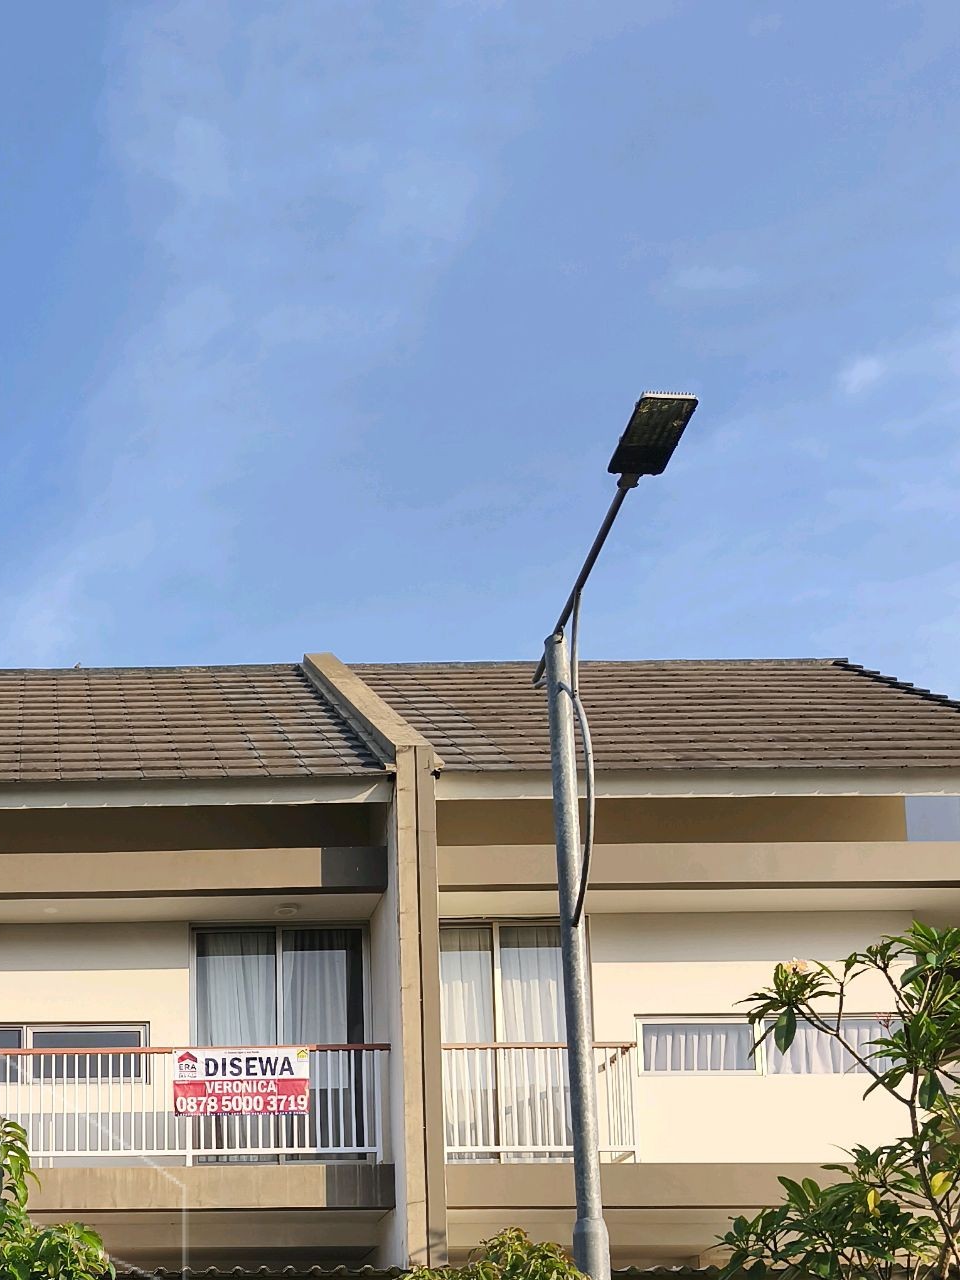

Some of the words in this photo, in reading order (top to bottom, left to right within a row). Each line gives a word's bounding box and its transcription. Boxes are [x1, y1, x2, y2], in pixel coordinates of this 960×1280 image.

[205, 1057, 294, 1076] DISEWA
[205, 1080, 277, 1094] VERONICA
[176, 1096, 219, 1113] 0878
[222, 1095, 264, 1112] 5000
[266, 1094, 308, 1111] 3719
